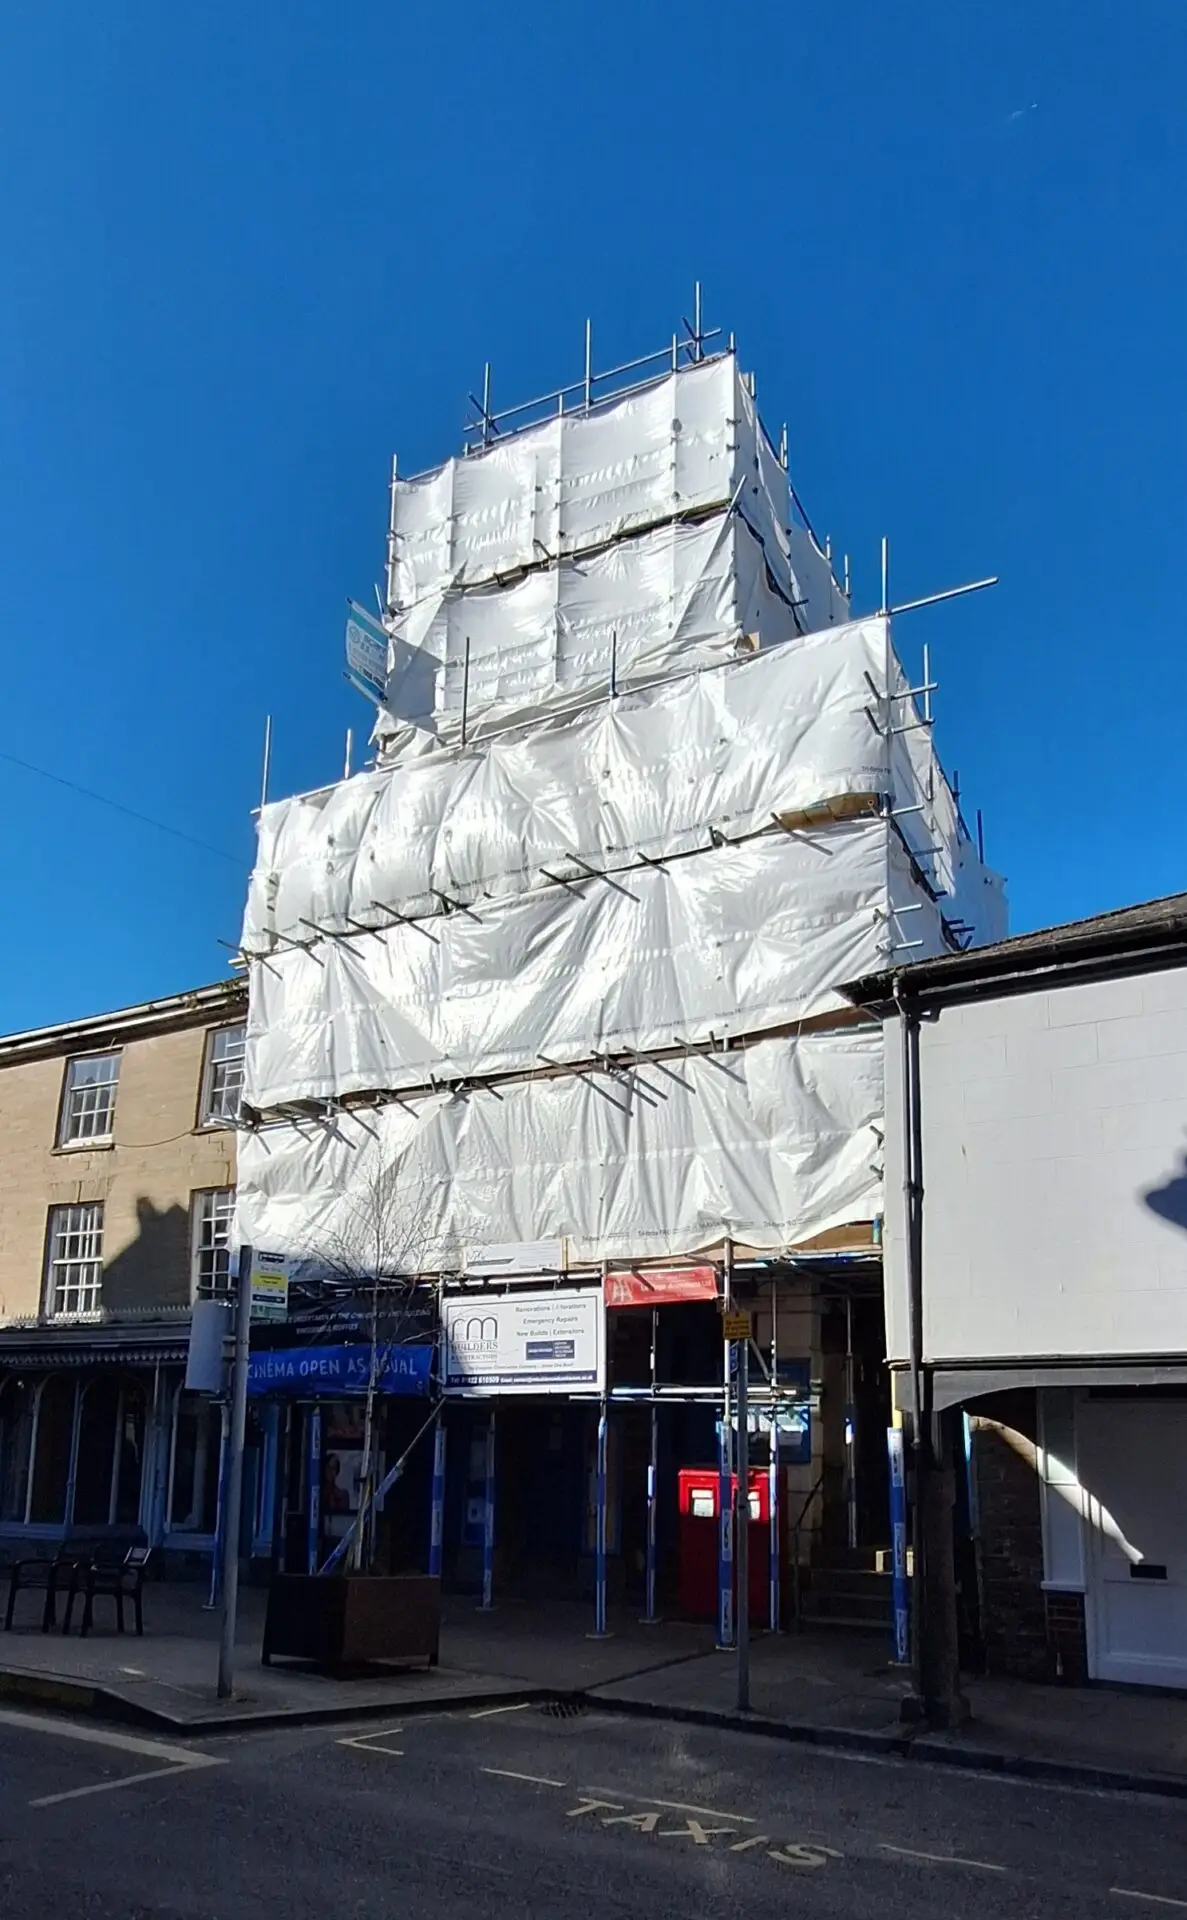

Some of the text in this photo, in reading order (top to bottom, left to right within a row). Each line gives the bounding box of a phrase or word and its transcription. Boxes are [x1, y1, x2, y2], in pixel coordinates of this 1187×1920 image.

[523, 1317, 555, 1325] Emergency
[300, 1359, 340, 1376] OPEN
[347, 1358, 367, 1374] AS
[566, 1798, 844, 1867] TAXIS
